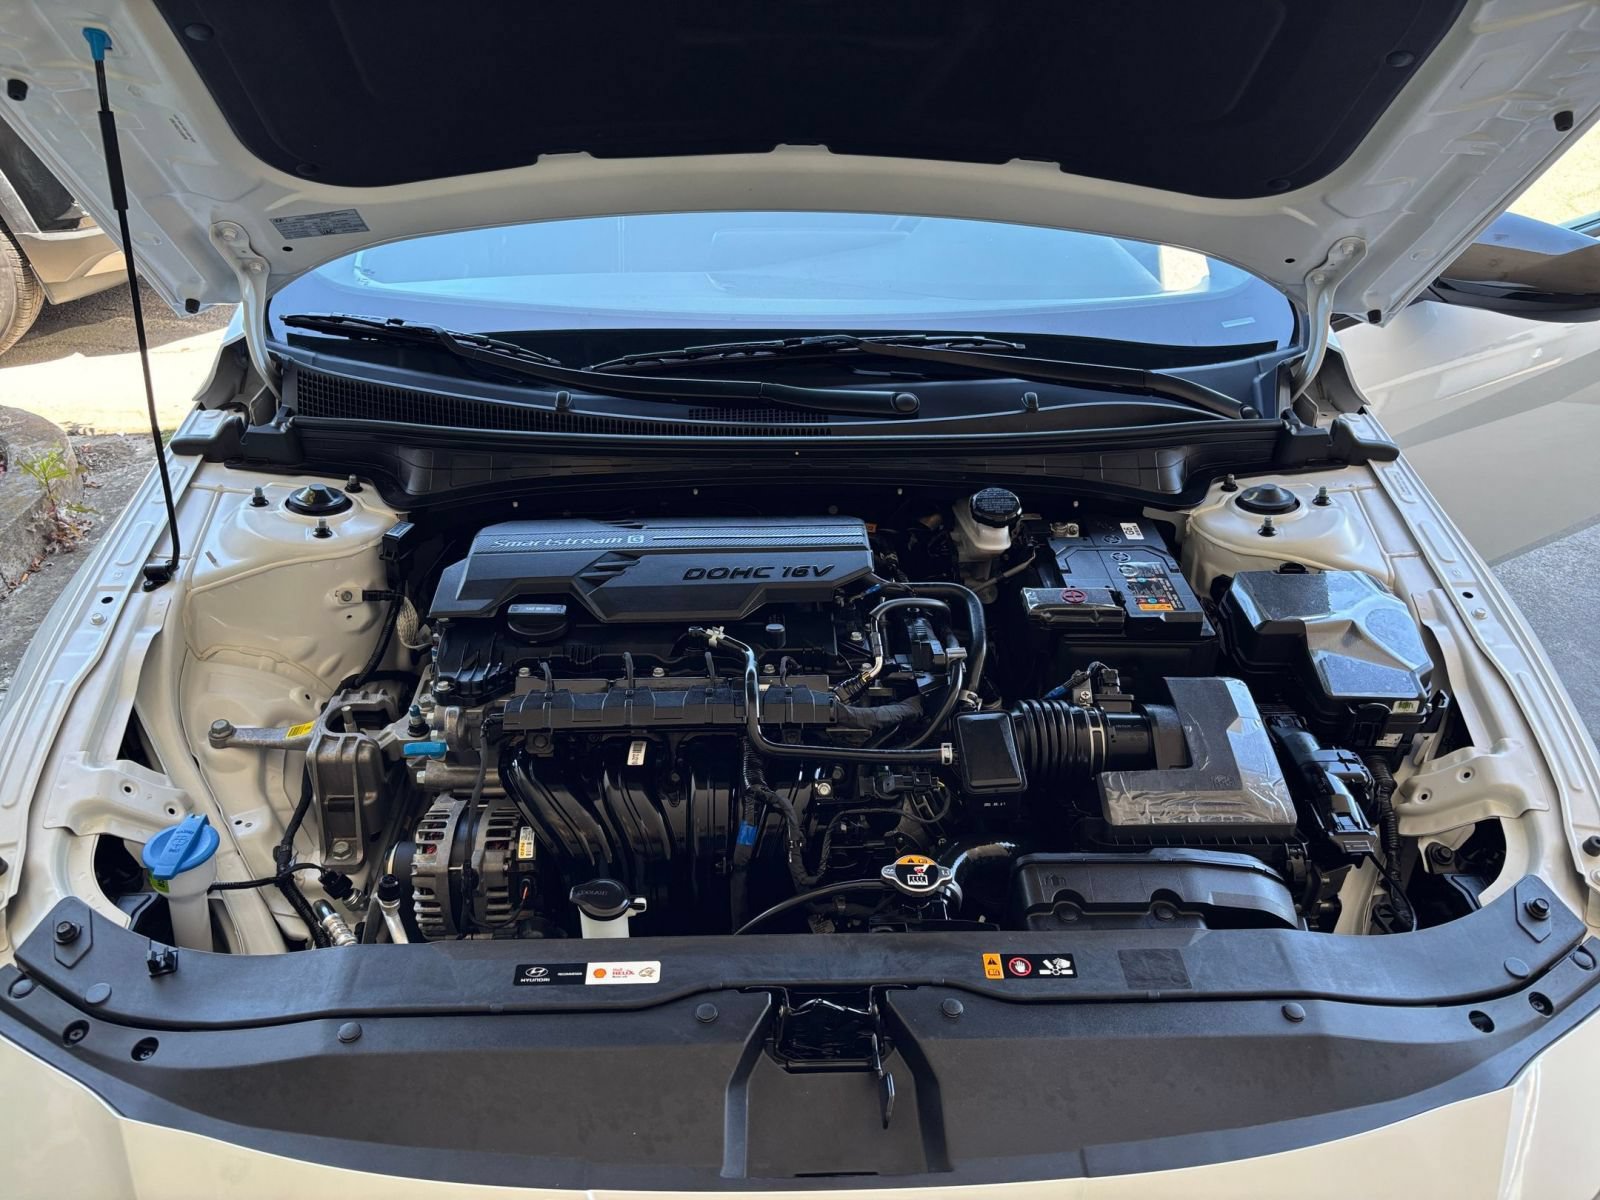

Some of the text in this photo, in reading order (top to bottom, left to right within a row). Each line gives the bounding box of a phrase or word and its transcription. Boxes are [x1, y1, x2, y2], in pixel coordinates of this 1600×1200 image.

[491, 537, 623, 548] Smartstream
[682, 565, 835, 581] DOHC 16V
